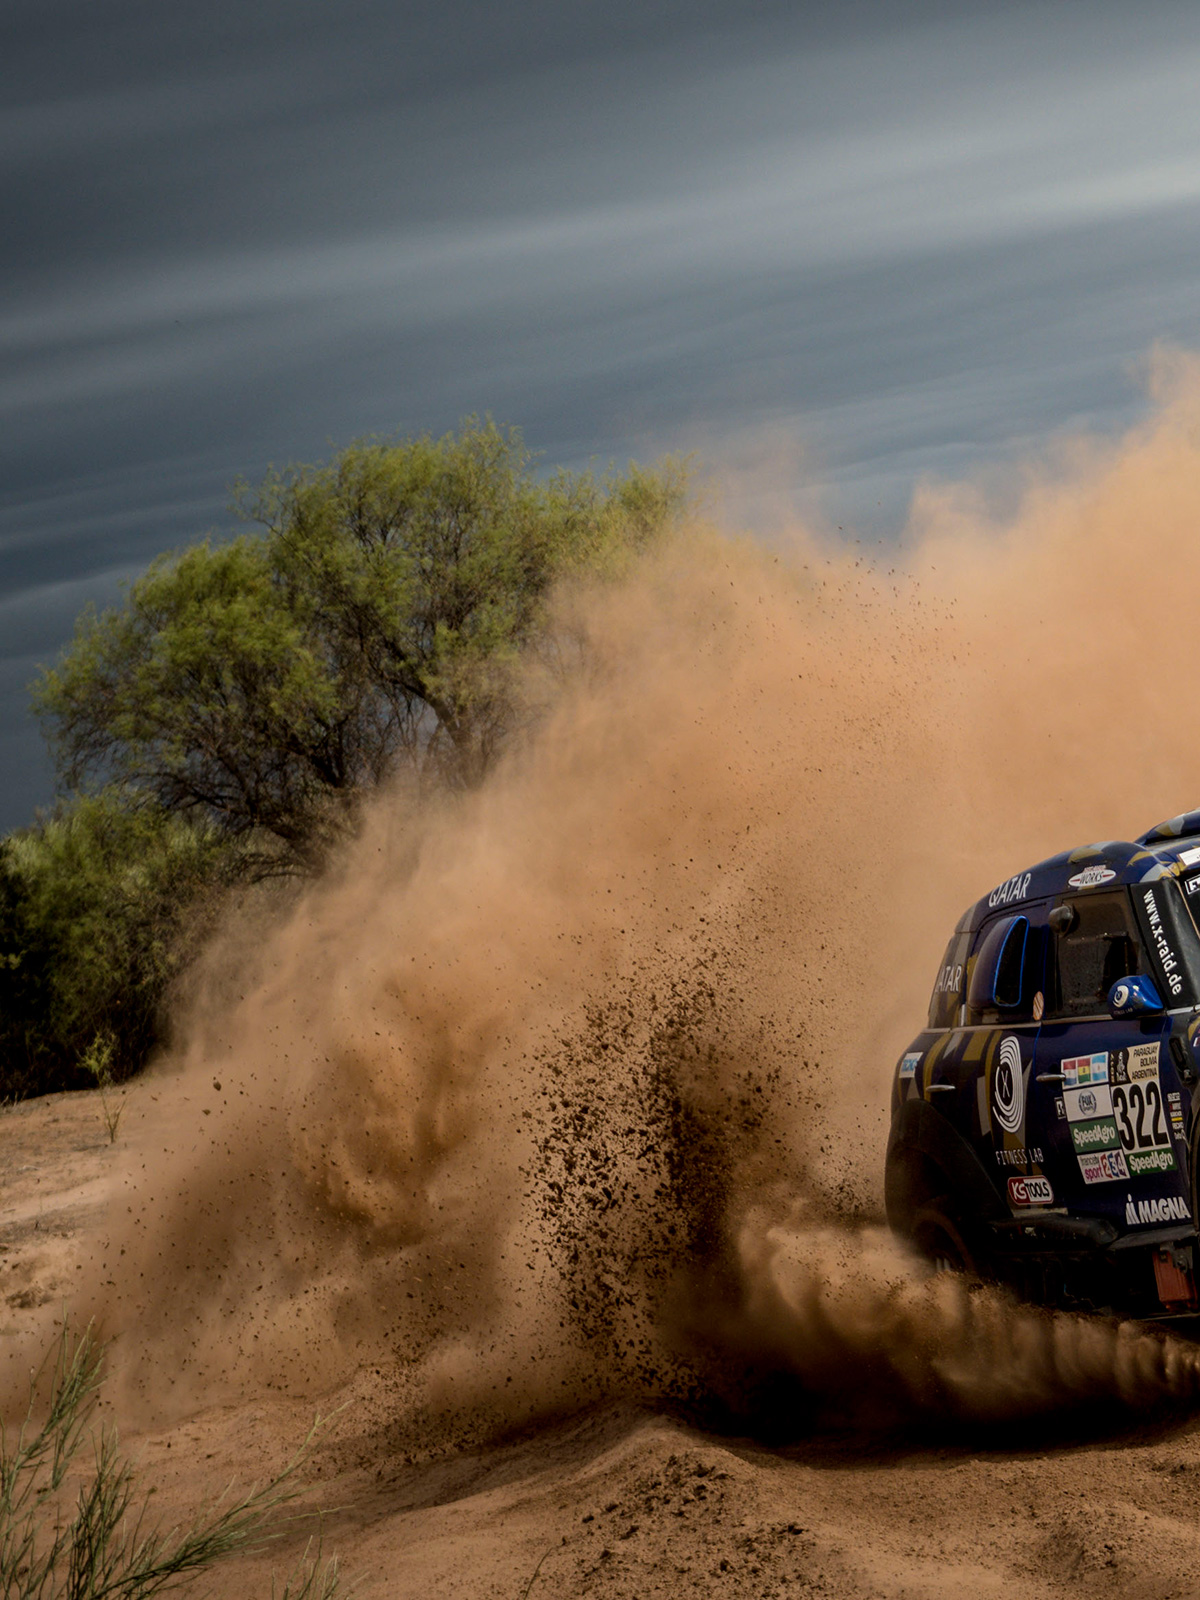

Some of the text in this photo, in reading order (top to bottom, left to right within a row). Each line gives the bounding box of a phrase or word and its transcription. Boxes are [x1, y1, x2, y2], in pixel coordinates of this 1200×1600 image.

[988, 873, 1031, 907] QATAR
[1143, 889, 1182, 995] www.x-raid.de
[1133, 1044, 1159, 1058] PARAGUAY
[1140, 1056, 1157, 1067] BOLIVIA
[1131, 1067, 1157, 1080] ARGENTINA
[1113, 1081, 1169, 1150] 322
[1073, 1125, 1115, 1147] SpeedAgro
[995, 1148, 1044, 1165] FITNESS LAB
[1129, 1151, 1173, 1173] SpeedAgro
[1085, 1165, 1103, 1181] sport
[1138, 1197, 1191, 1223] MAGNA
